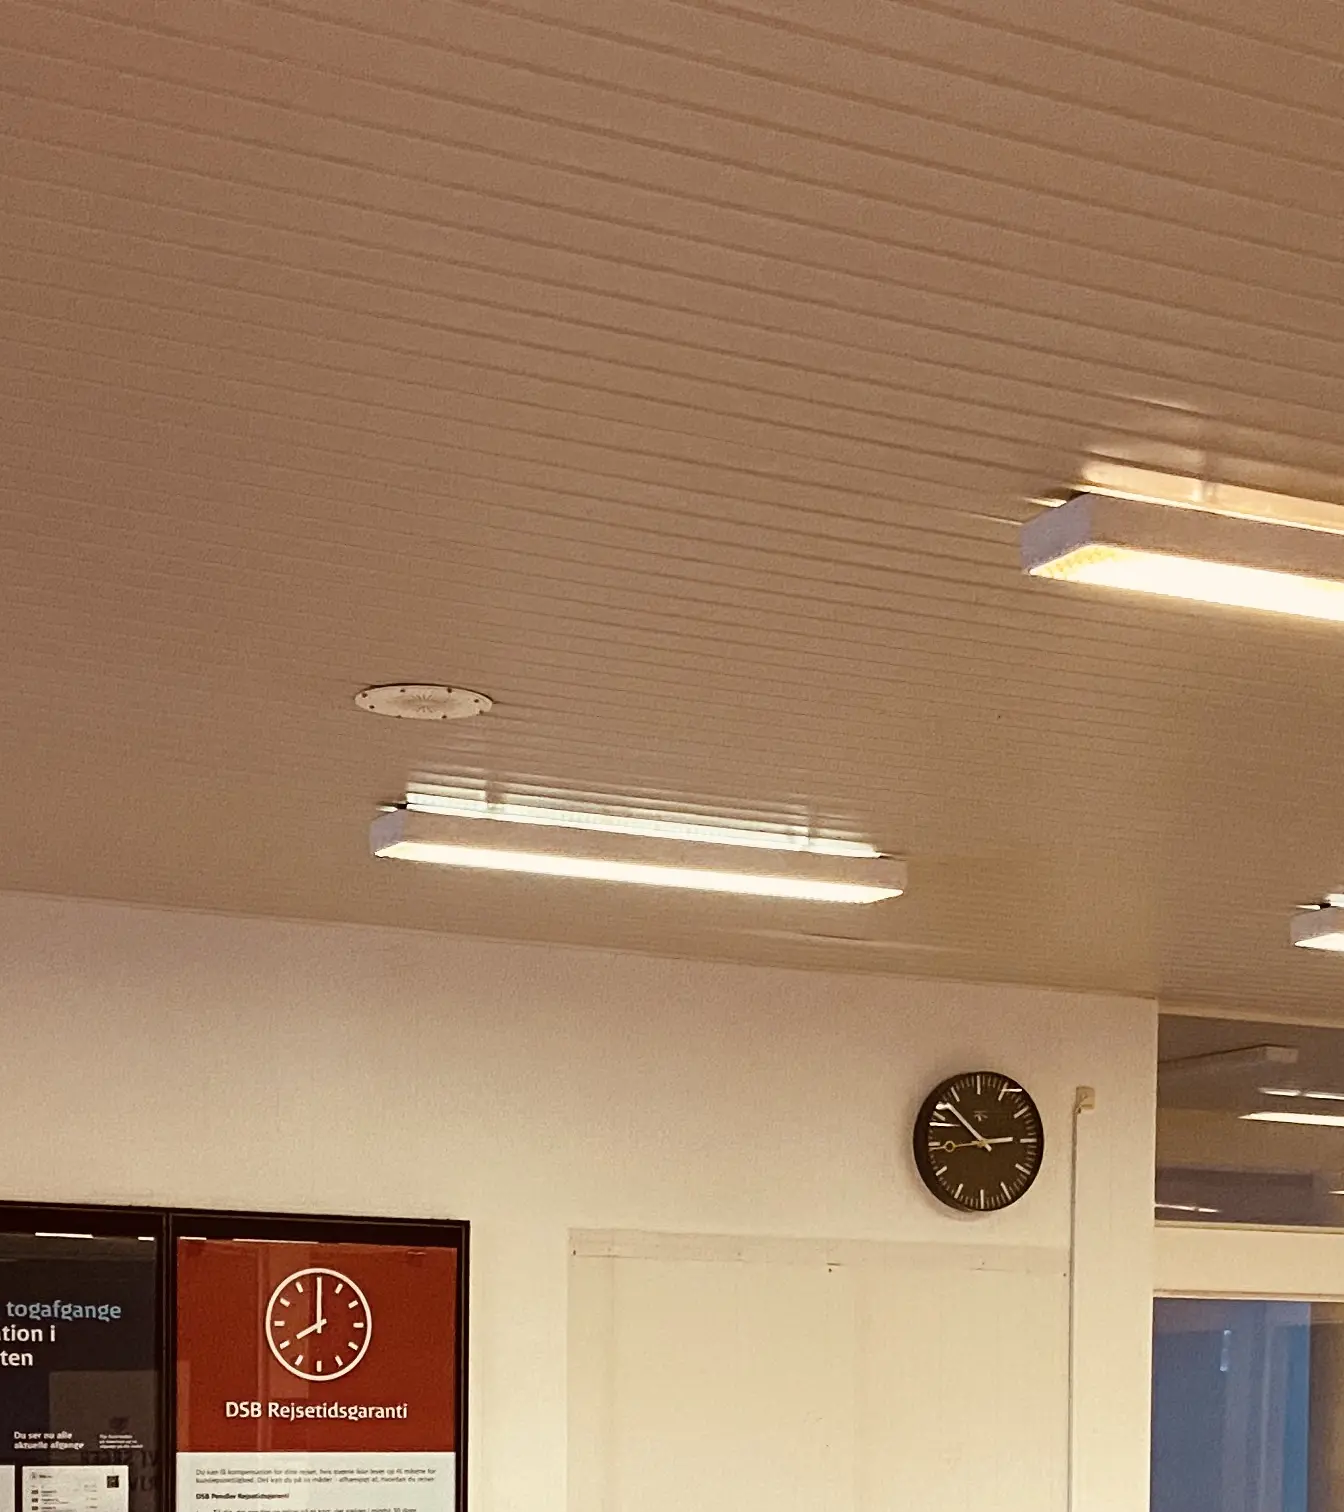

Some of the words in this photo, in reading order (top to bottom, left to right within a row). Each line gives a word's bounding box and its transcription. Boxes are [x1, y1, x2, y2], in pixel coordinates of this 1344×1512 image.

[6, 1300, 122, 1322] togafgange
[50, 1325, 56, 1342] i
[226, 1401, 262, 1417] DSB
[268, 1402, 408, 1421] Rejsetidsgaranti
[14, 1431, 26, 1440] Du
